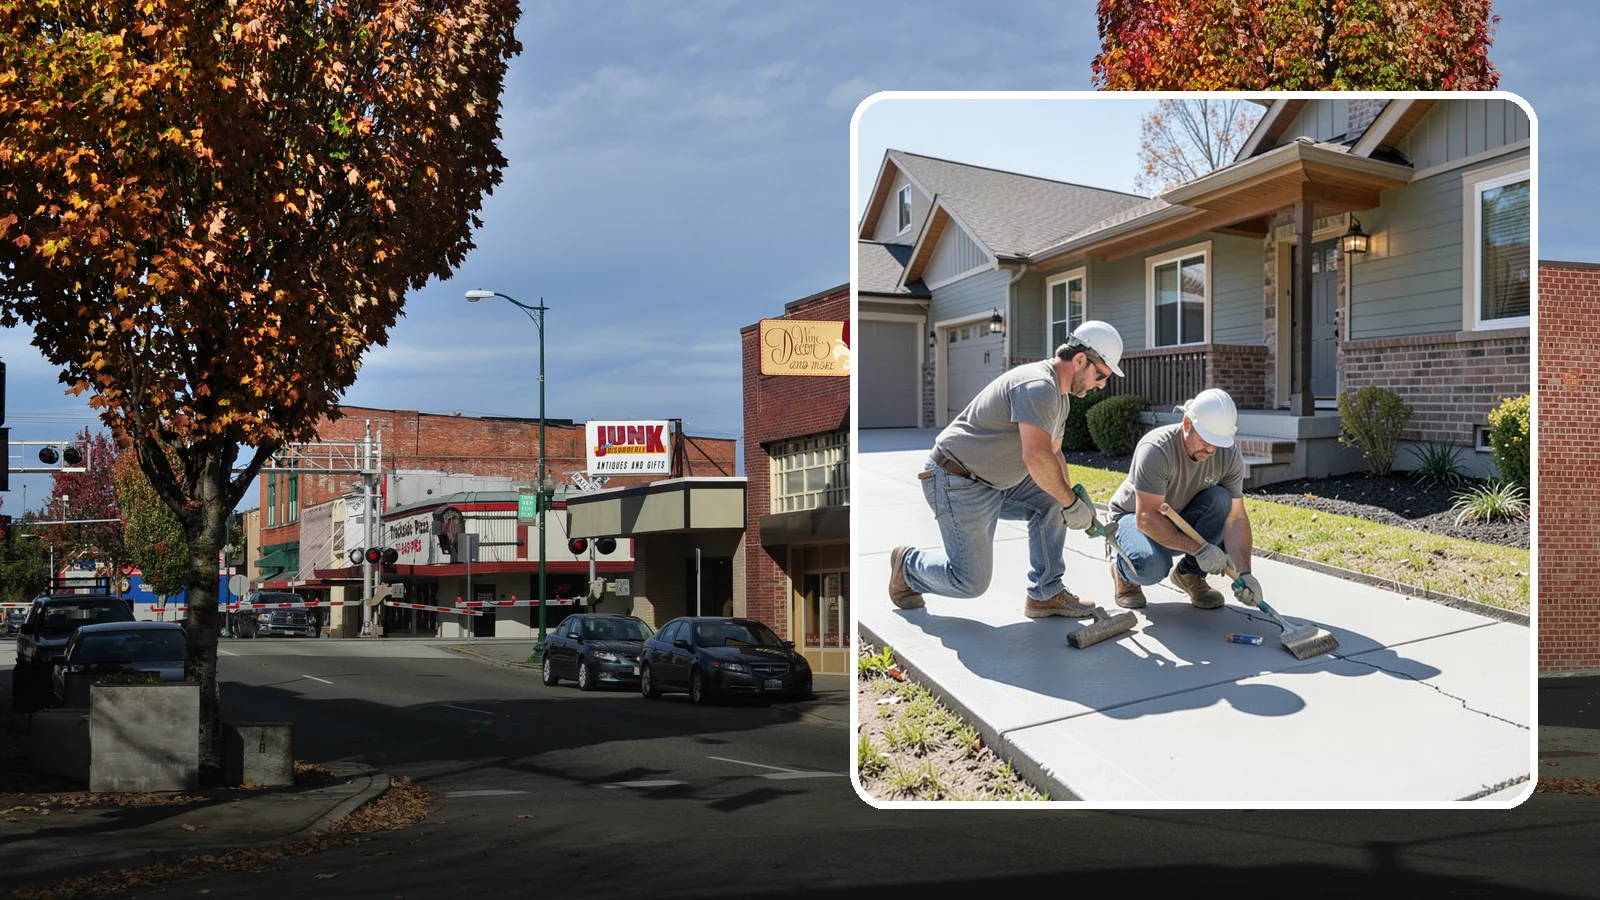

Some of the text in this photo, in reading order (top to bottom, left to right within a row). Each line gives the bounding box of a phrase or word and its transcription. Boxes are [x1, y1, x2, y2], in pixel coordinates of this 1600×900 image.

[595, 425, 665, 457] JUNK
[607, 446, 646, 454] DISORDERLY
[596, 460, 665, 470] ANTIQUES AND GIFTS
[414, 519, 429, 535] Pizza
